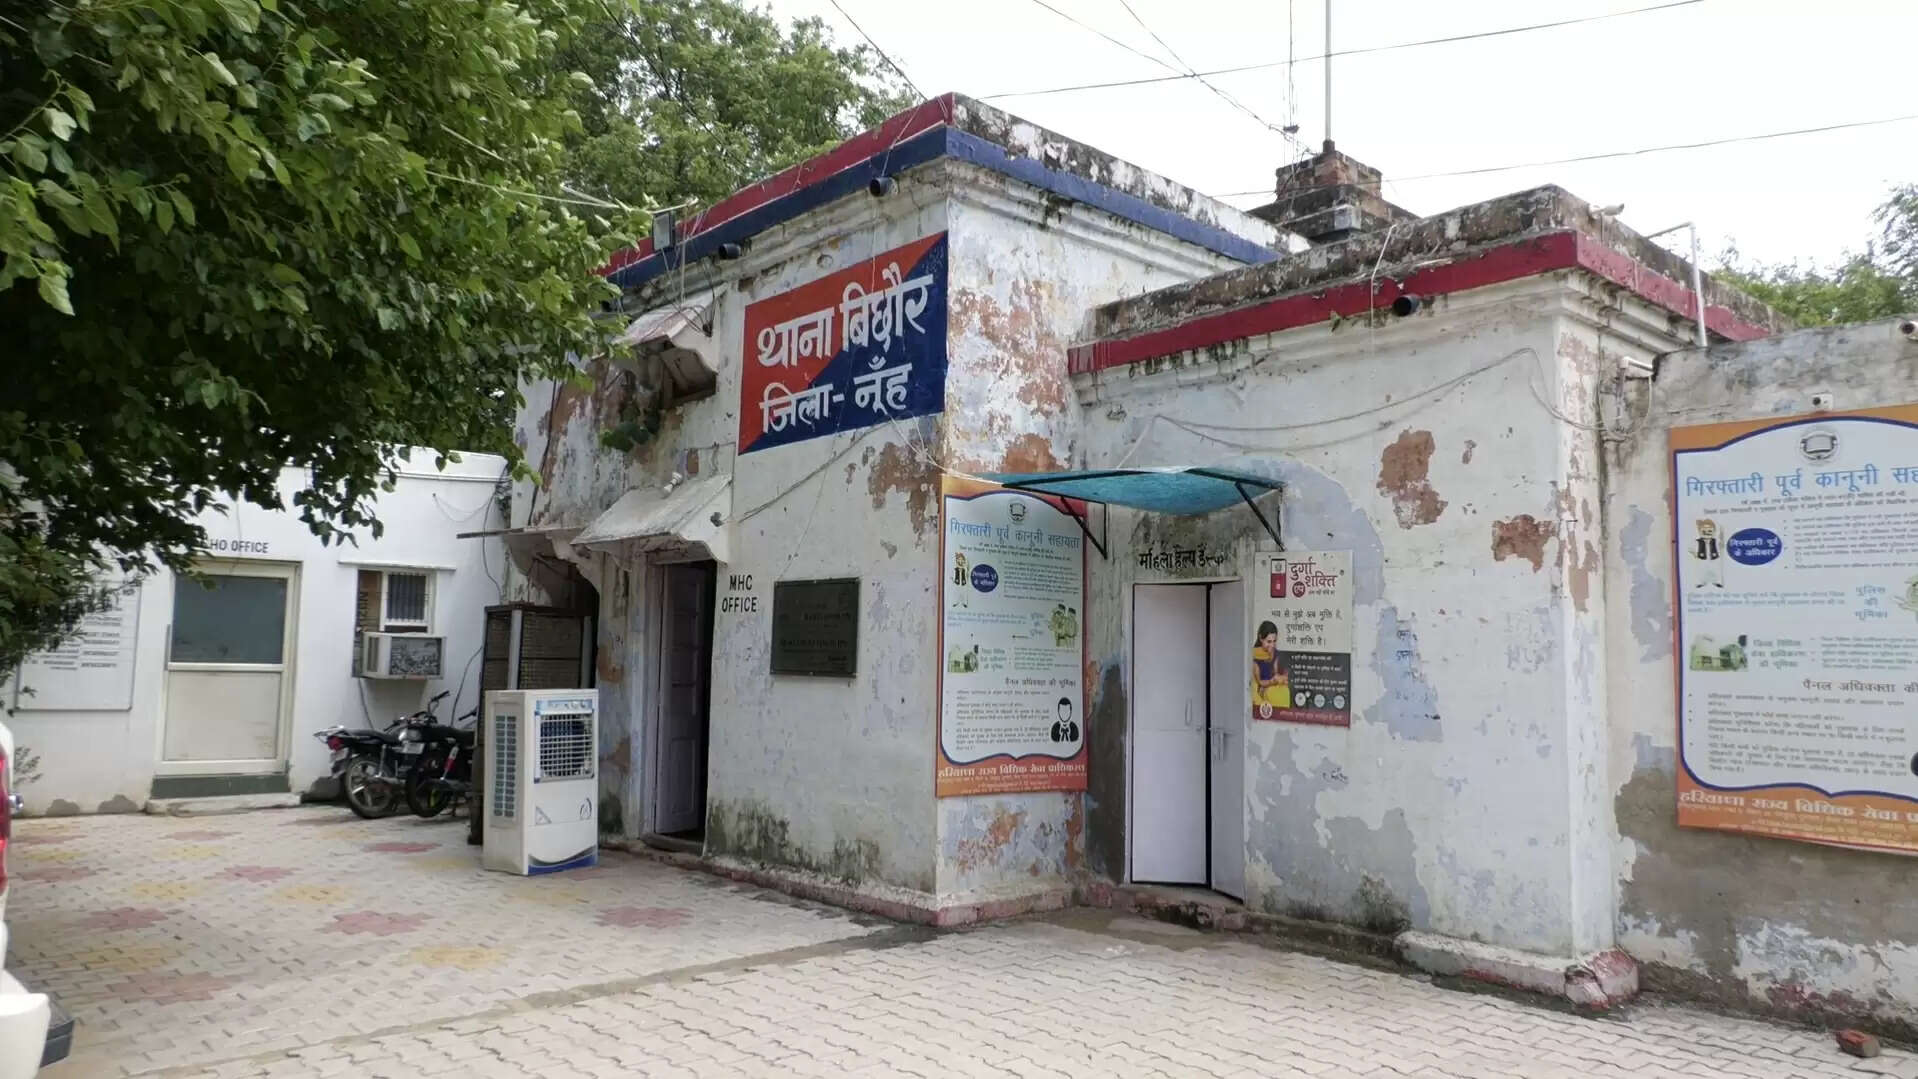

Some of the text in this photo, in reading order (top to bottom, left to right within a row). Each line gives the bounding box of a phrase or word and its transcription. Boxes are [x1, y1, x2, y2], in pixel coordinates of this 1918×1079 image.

[757, 307, 834, 368] थाना
[1686, 472, 1763, 496] गिरफ्तारी
[1776, 467, 1802, 496] पूर्व
[1816, 464, 1879, 493] कानूनी
[203, 538, 269, 554] HO OFFICE
[1288, 557, 1316, 581] दुर्गा
[729, 575, 753, 591] MHC
[1305, 571, 1338, 588] शक्ति
[722, 597, 757, 613] OFFICE
